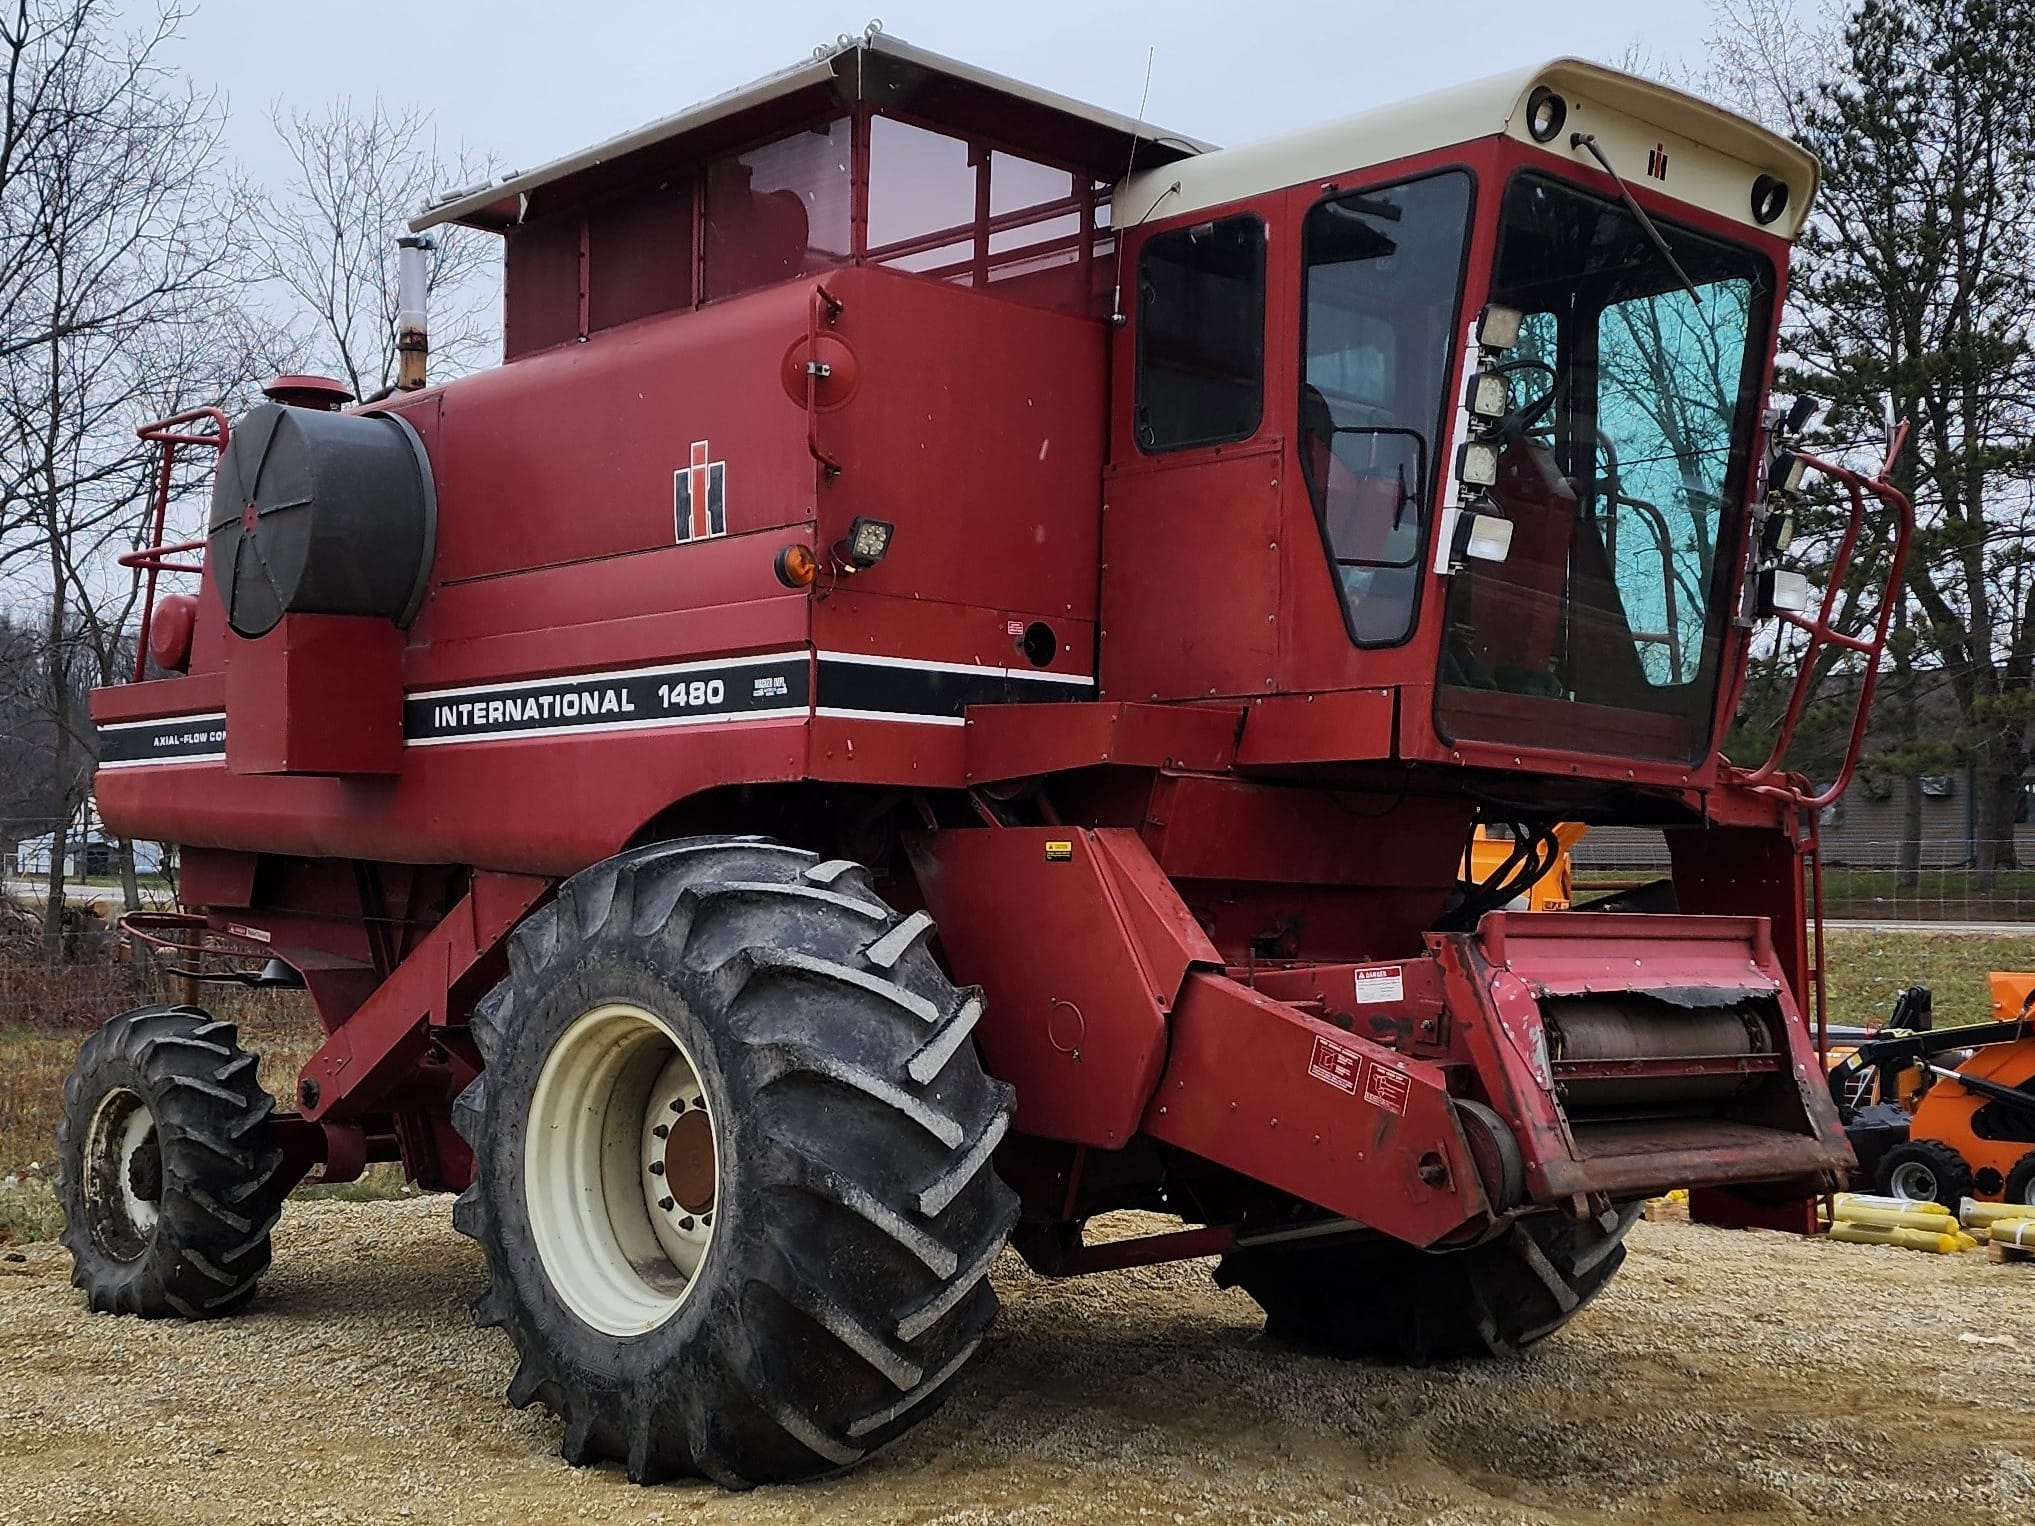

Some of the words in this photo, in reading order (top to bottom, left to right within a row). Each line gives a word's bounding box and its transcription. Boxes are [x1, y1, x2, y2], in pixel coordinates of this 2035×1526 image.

[433, 688, 635, 728] INTERNATIONAL
[657, 680, 725, 708] 1480
[153, 732, 208, 747] AXIAL-FLOW
